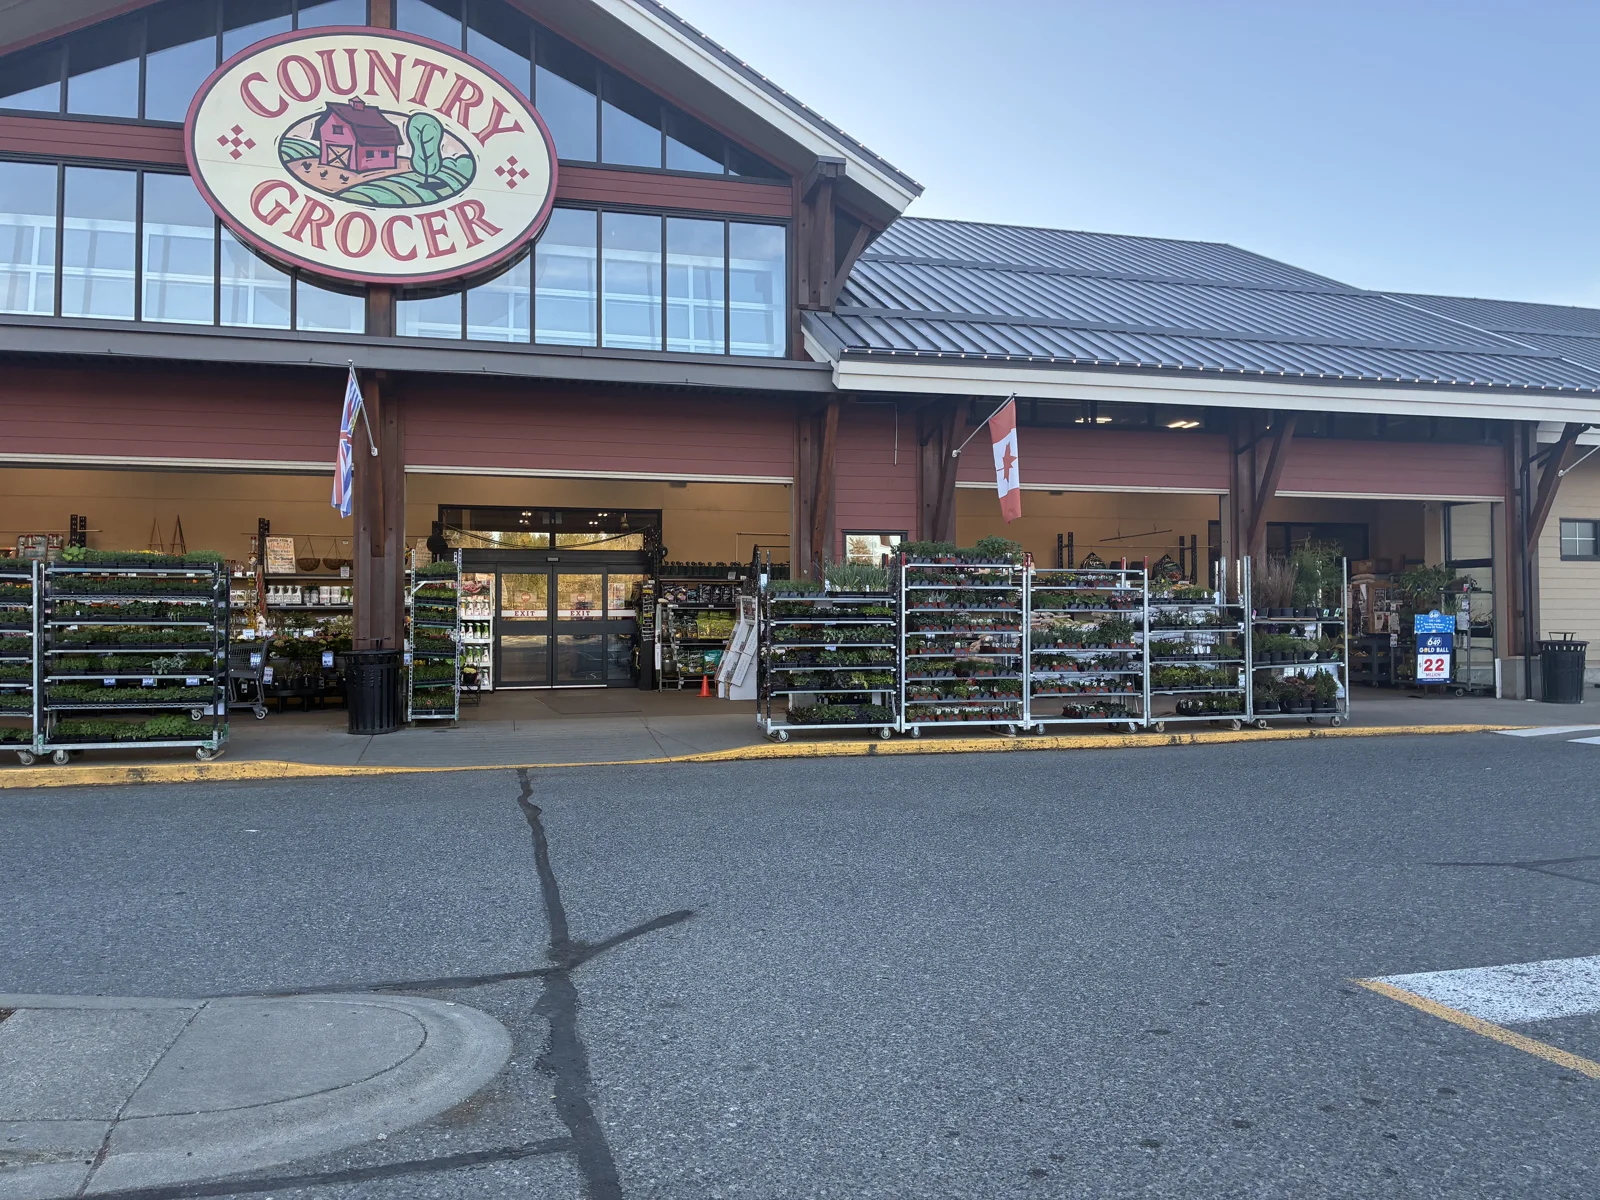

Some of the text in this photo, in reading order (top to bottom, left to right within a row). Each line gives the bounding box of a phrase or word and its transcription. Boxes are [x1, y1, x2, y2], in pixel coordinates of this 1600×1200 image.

[240, 48, 525, 148] COUNTRY
[250, 179, 503, 262] GROCER
[1424, 658, 1444, 672] 22
